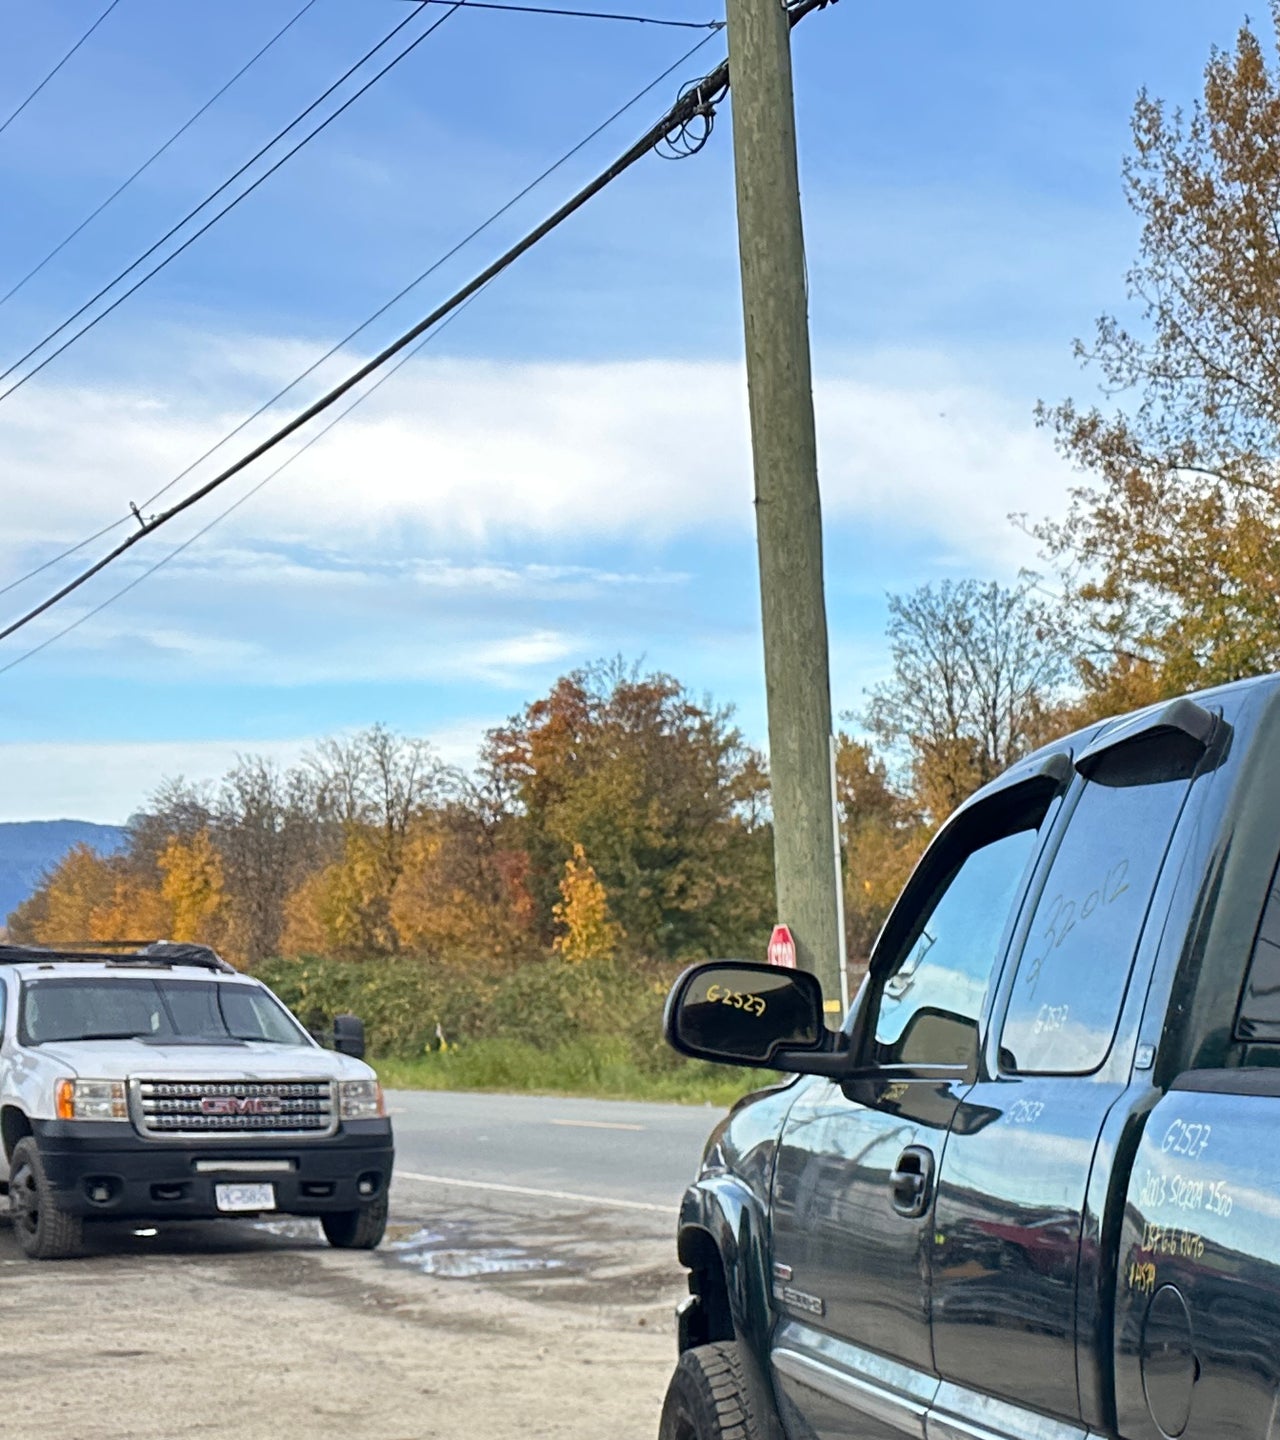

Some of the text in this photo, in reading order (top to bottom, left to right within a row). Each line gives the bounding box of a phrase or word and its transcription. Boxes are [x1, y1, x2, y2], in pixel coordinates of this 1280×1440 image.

[706, 984, 767, 1018] G2527
[201, 1097, 281, 1114] GMC
[1161, 1118, 1212, 1160] G2527
